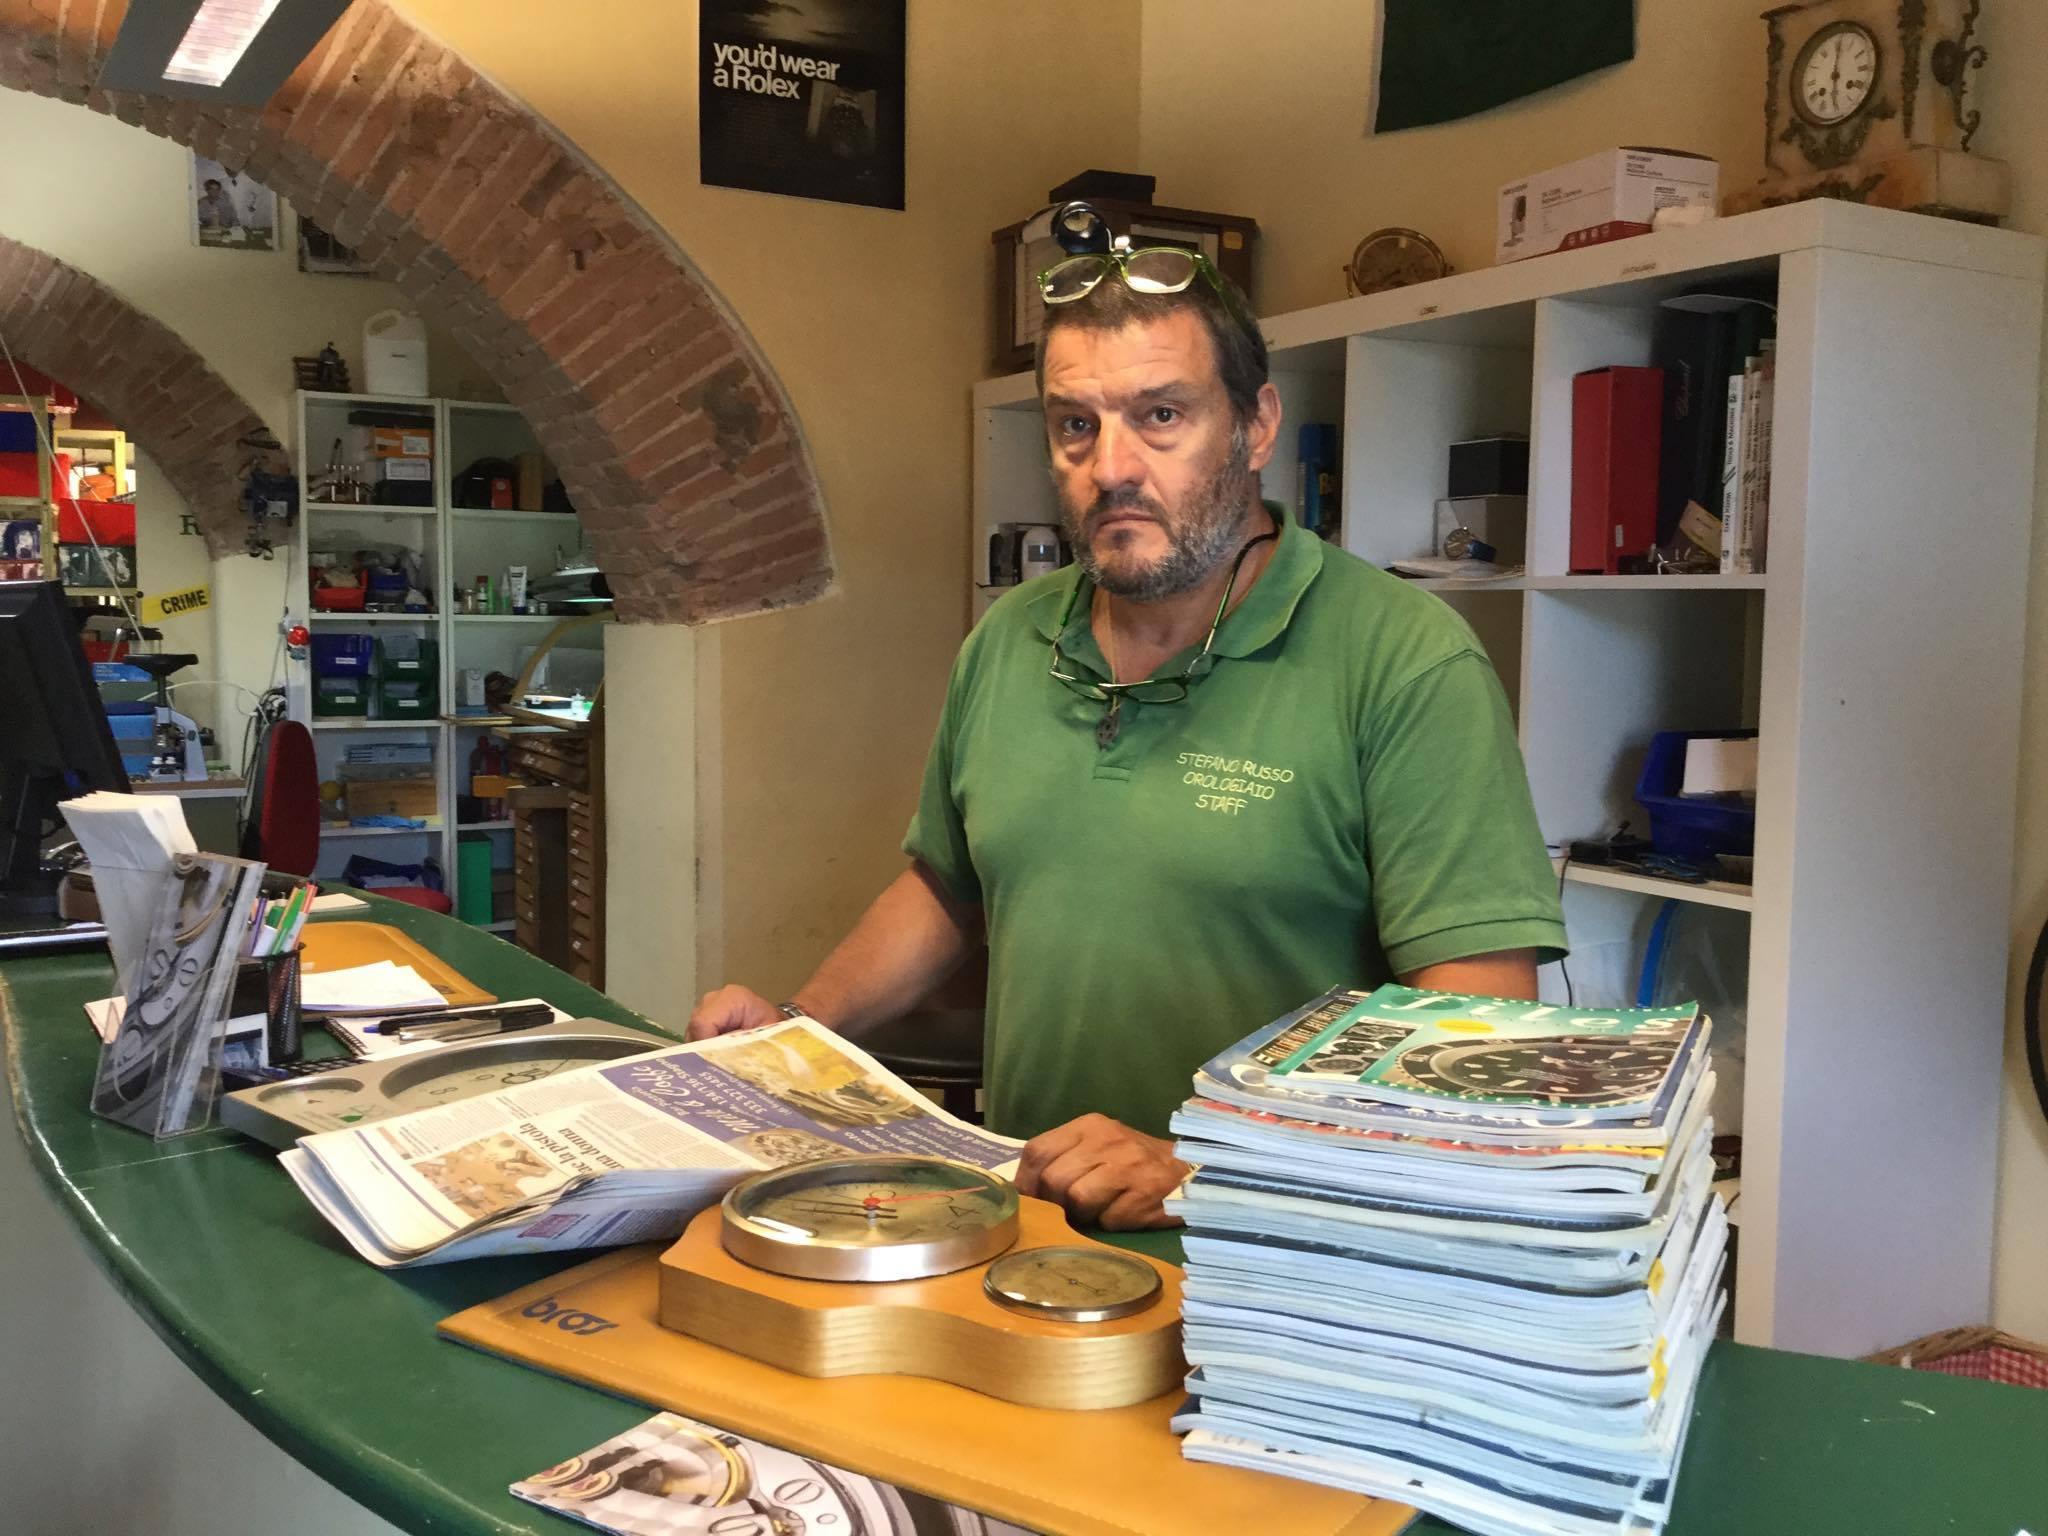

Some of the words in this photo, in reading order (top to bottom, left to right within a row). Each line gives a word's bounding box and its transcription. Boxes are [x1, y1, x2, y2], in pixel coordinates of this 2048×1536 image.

[713, 42, 777, 70] you'd
[779, 53, 841, 81] wear
[713, 68, 729, 88] a
[733, 66, 800, 100] Rolex
[161, 590, 208, 615] CRIME
[1176, 752, 1240, 773] STEFANO
[1242, 760, 1295, 783] RUSSO
[1183, 771, 1276, 800] OROLOGIAIO
[1194, 794, 1249, 816] STAFF
[519, 1123, 569, 1154] pistola
[558, 1127, 600, 1155] donna
[559, 1152, 576, 1164] la
